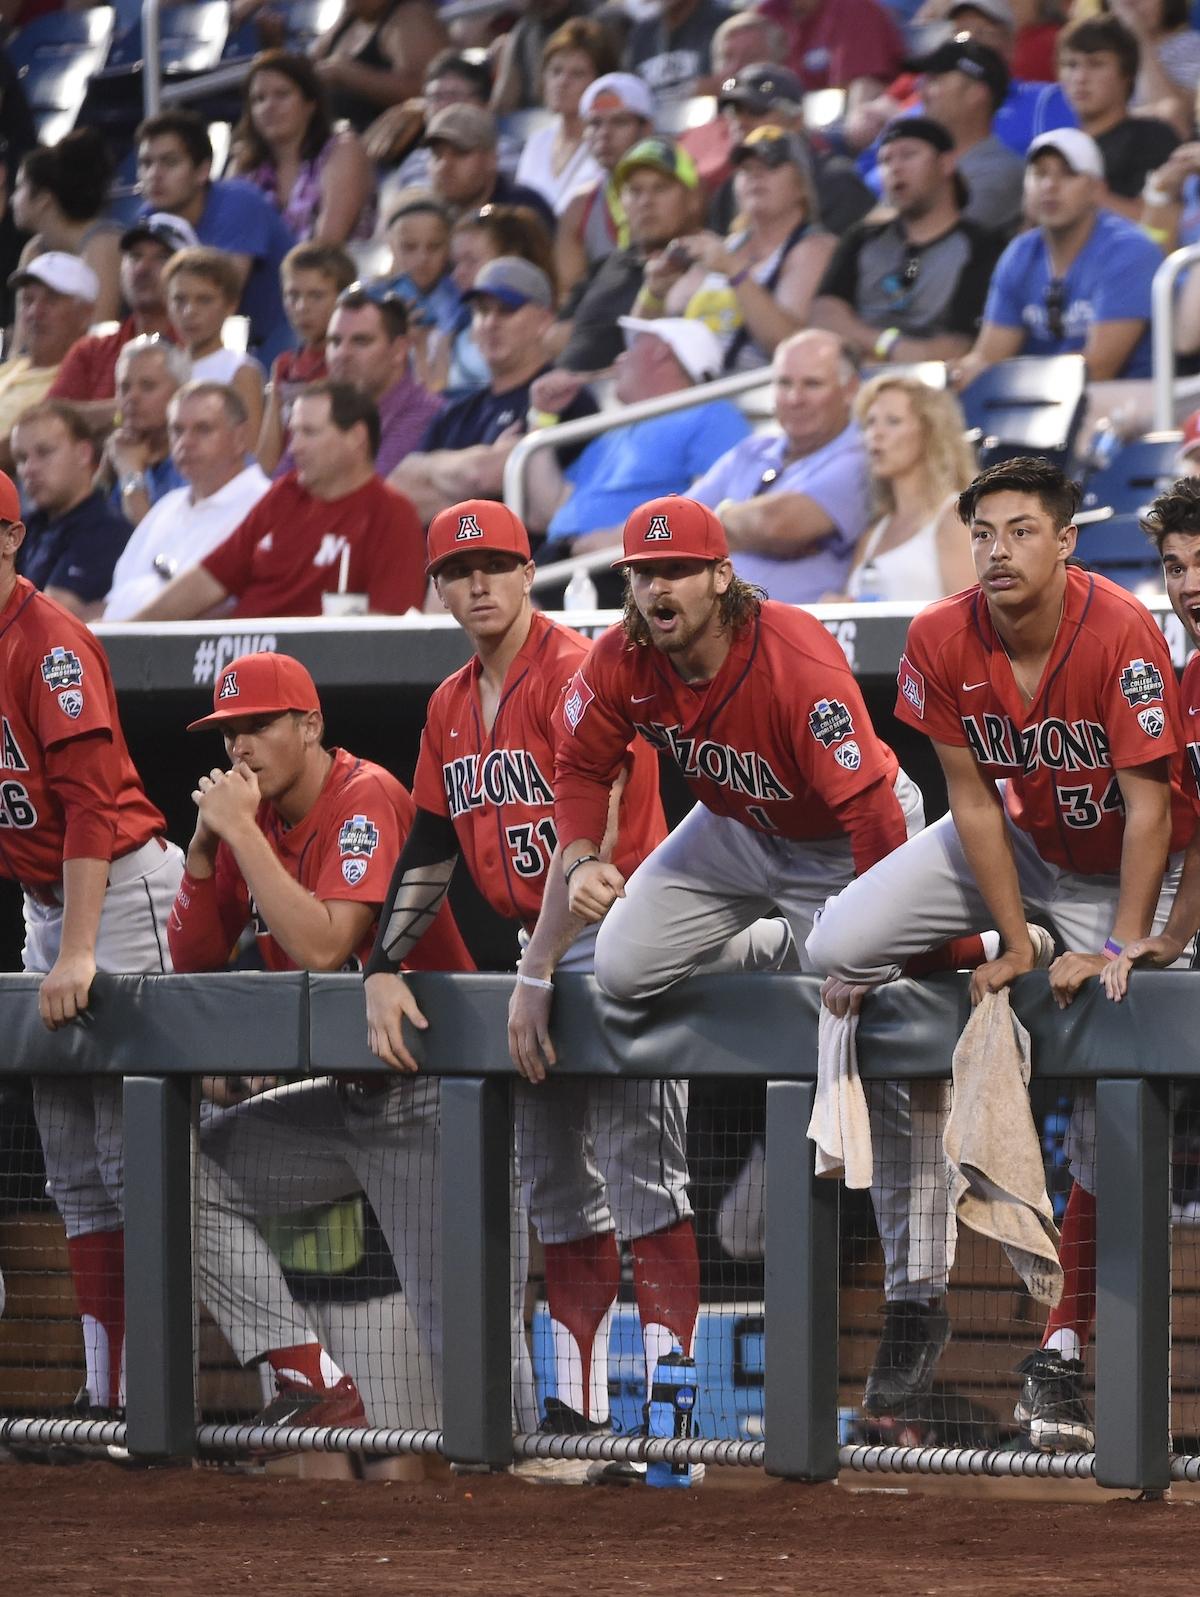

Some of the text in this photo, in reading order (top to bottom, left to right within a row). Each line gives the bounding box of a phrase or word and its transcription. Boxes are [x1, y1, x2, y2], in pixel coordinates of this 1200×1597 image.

[455, 514, 483, 542] A
[644, 515, 672, 541] A
[219, 671, 240, 700] A
[632, 721, 794, 801] IZONA
[0, 779, 38, 830] 6
